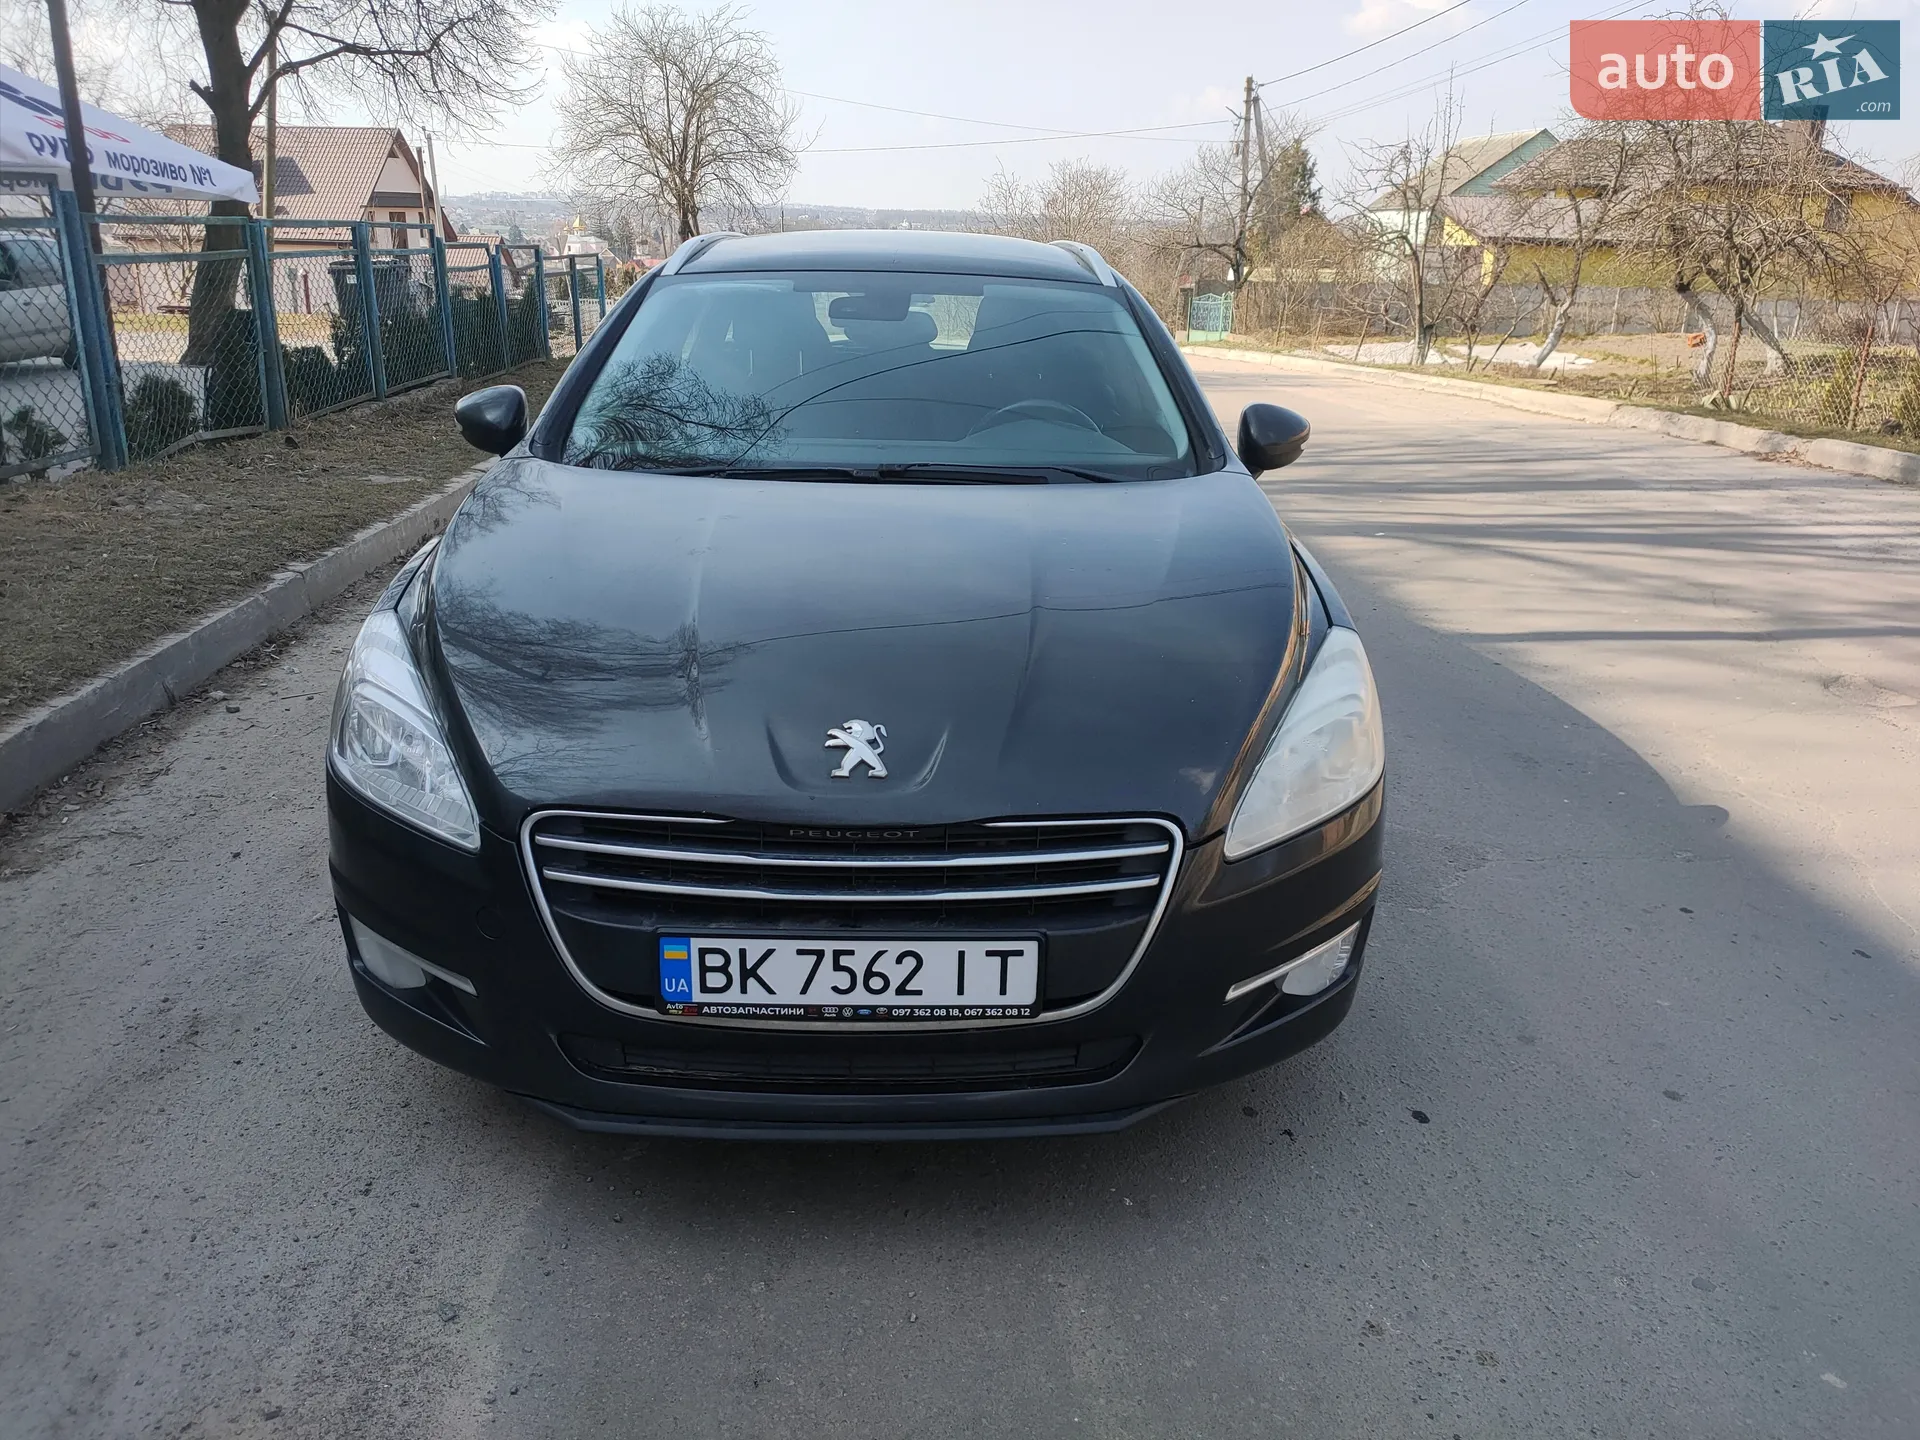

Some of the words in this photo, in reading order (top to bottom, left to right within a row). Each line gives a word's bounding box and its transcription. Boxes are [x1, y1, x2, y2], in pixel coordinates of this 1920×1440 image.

[789, 829, 920, 838] PEUGEOT
[698, 947, 777, 995] BK
[795, 949, 924, 996] 7562
[664, 977, 689, 993] UA
[701, 1005, 804, 1016] АВТОЗАПЧАСТИНИ
[892, 1008, 911, 1016] 097
[913, 1008, 931, 1016] 362
[933, 1008, 947, 1016] 08
[949, 1008, 962, 1017] 18,
[964, 1008, 983, 1016] 067
[985, 1008, 1003, 1016] 362
[1005, 1008, 1018, 1016] 08
[1020, 1008, 1031, 1016] 12
